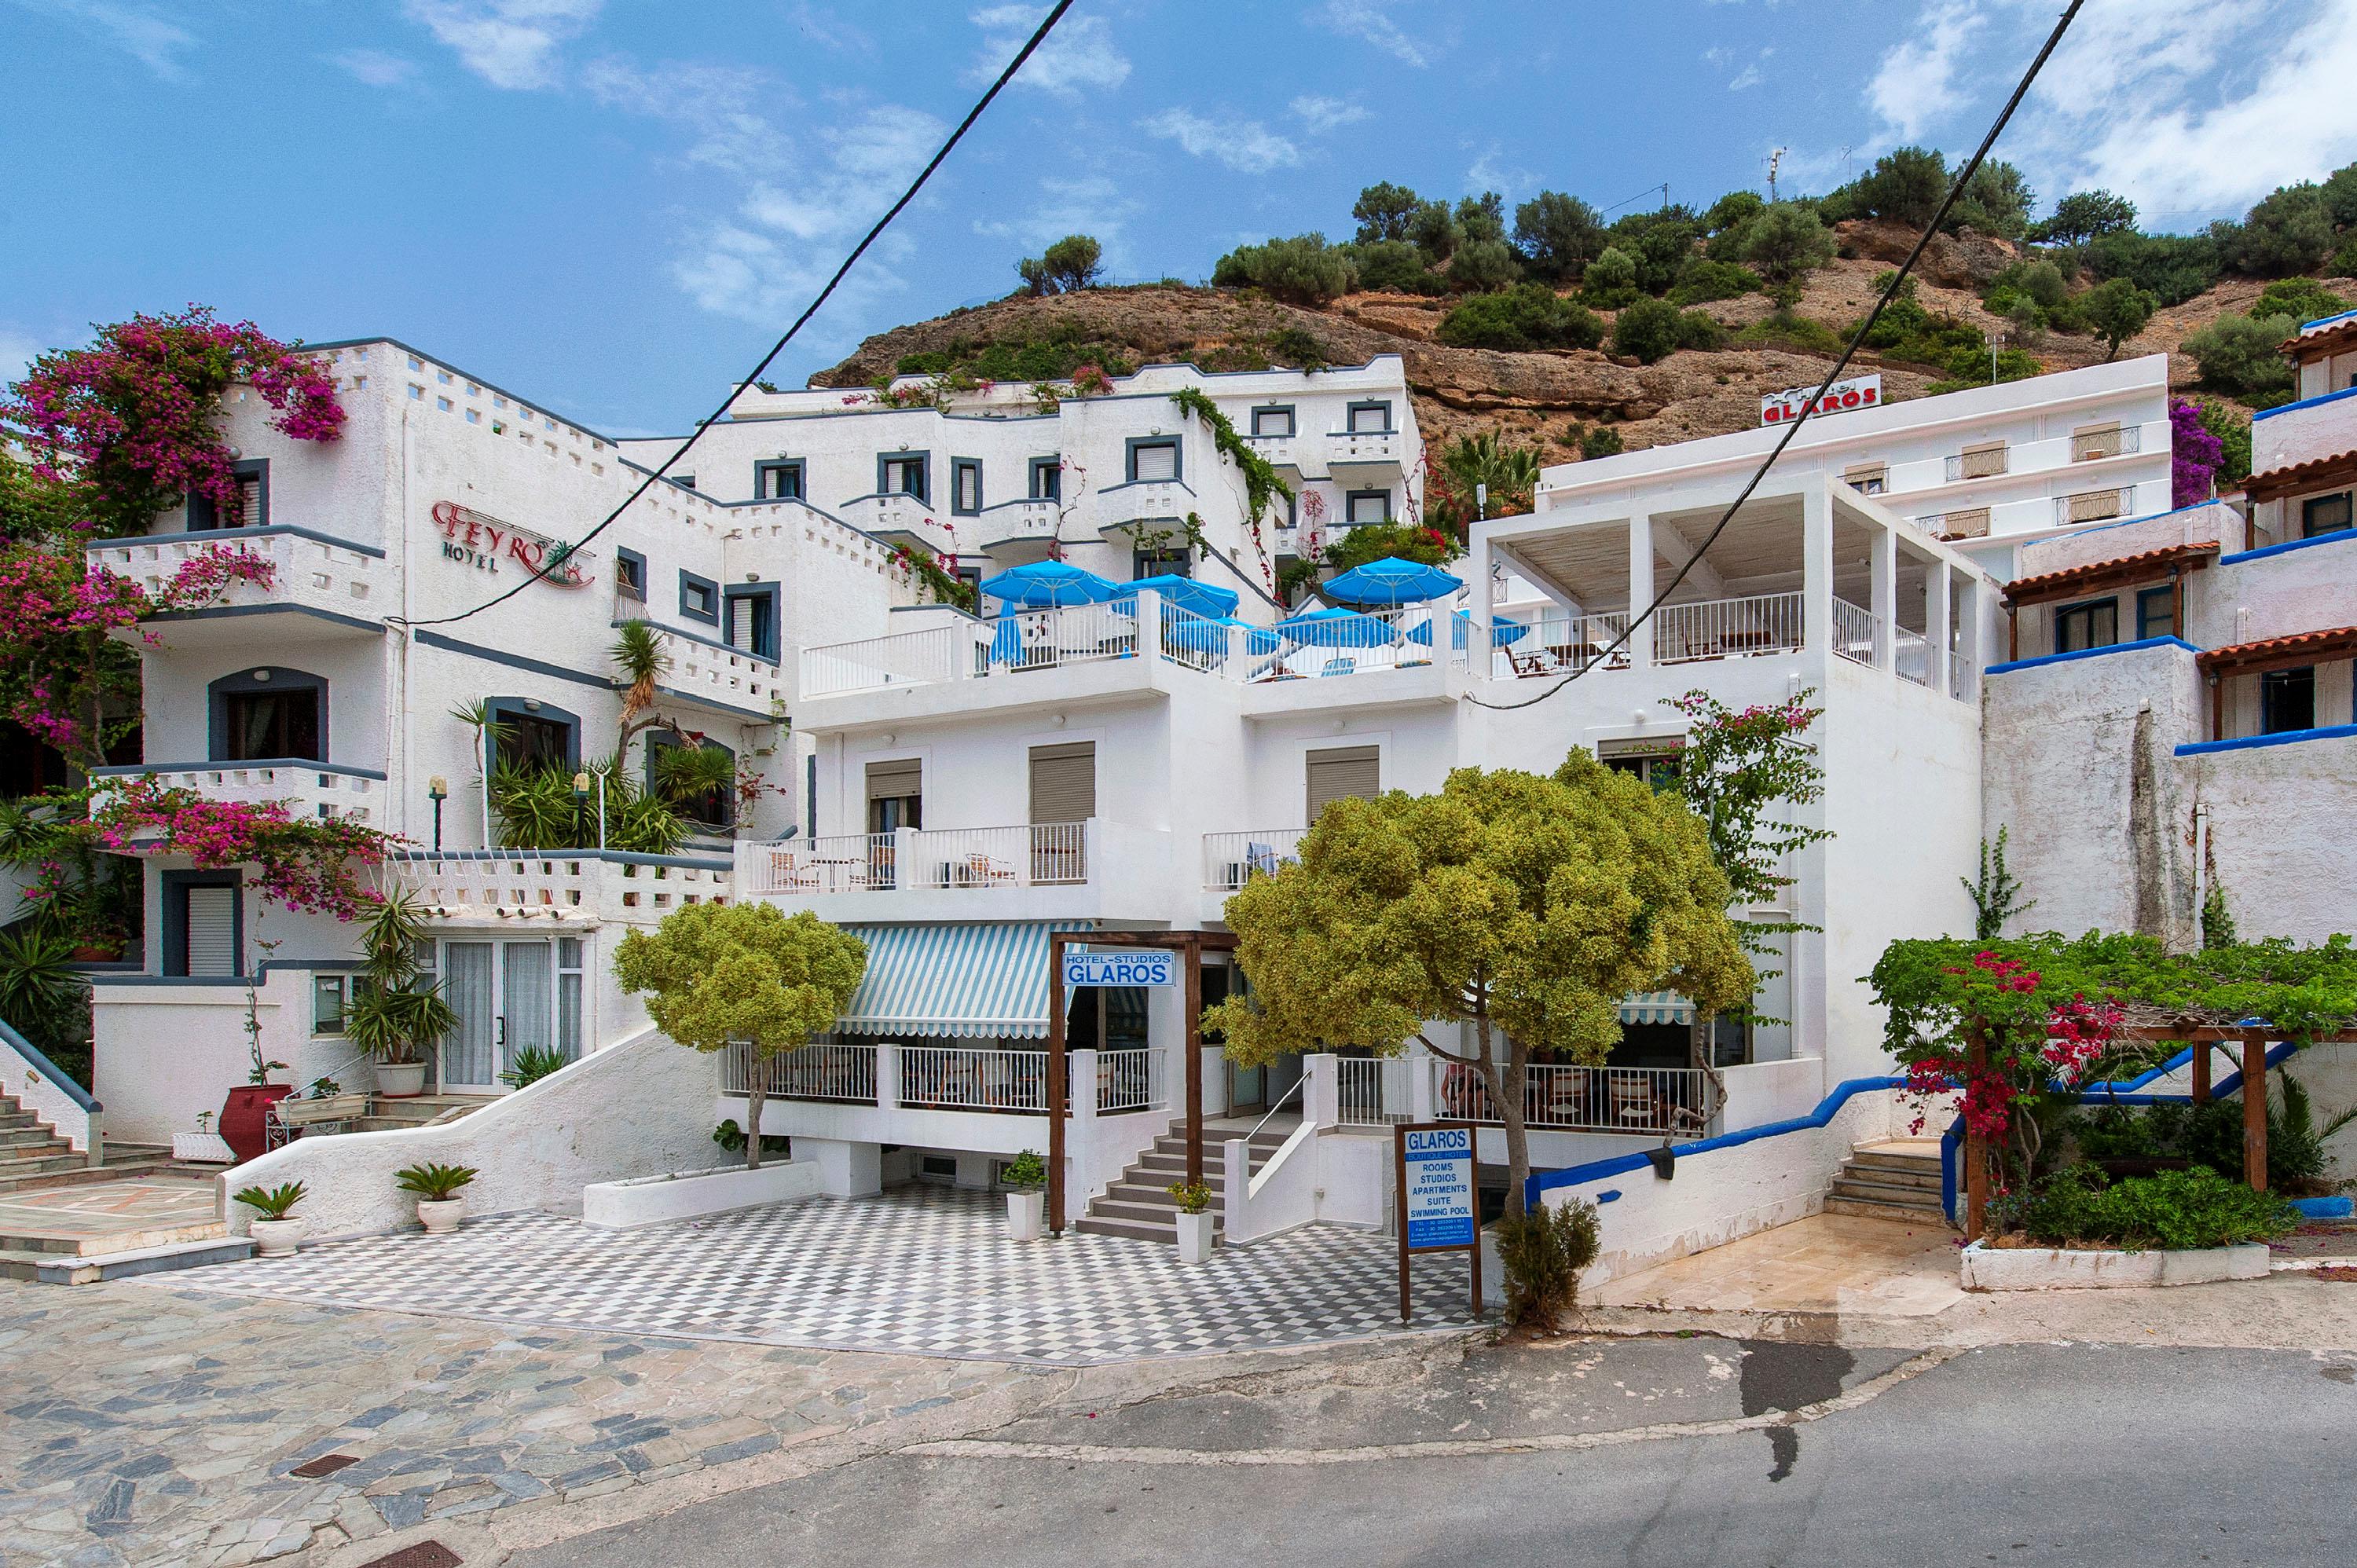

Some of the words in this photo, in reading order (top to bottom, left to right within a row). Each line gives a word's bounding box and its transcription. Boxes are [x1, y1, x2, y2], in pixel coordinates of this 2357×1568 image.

[1797, 381, 1856, 401] Htel
[1764, 388, 1876, 422] GLAROS
[442, 541, 498, 573] HOTEL
[1066, 955, 1171, 964] HOTEL-STUDIOS
[1069, 965, 1166, 983] GLAROS
[1409, 1130, 1466, 1150] GLAROS
[1408, 1152, 1443, 1160] BOUTIQUE
[1423, 1163, 1453, 1171] ROOMS
[1420, 1174, 1457, 1183] STUDIOS
[1412, 1185, 1468, 1195] APARTMENTS
[1427, 1196, 1451, 1205] SUITE
[1410, 1207, 1448, 1217] SWIMMING
[1450, 1206, 1469, 1214] POOL
